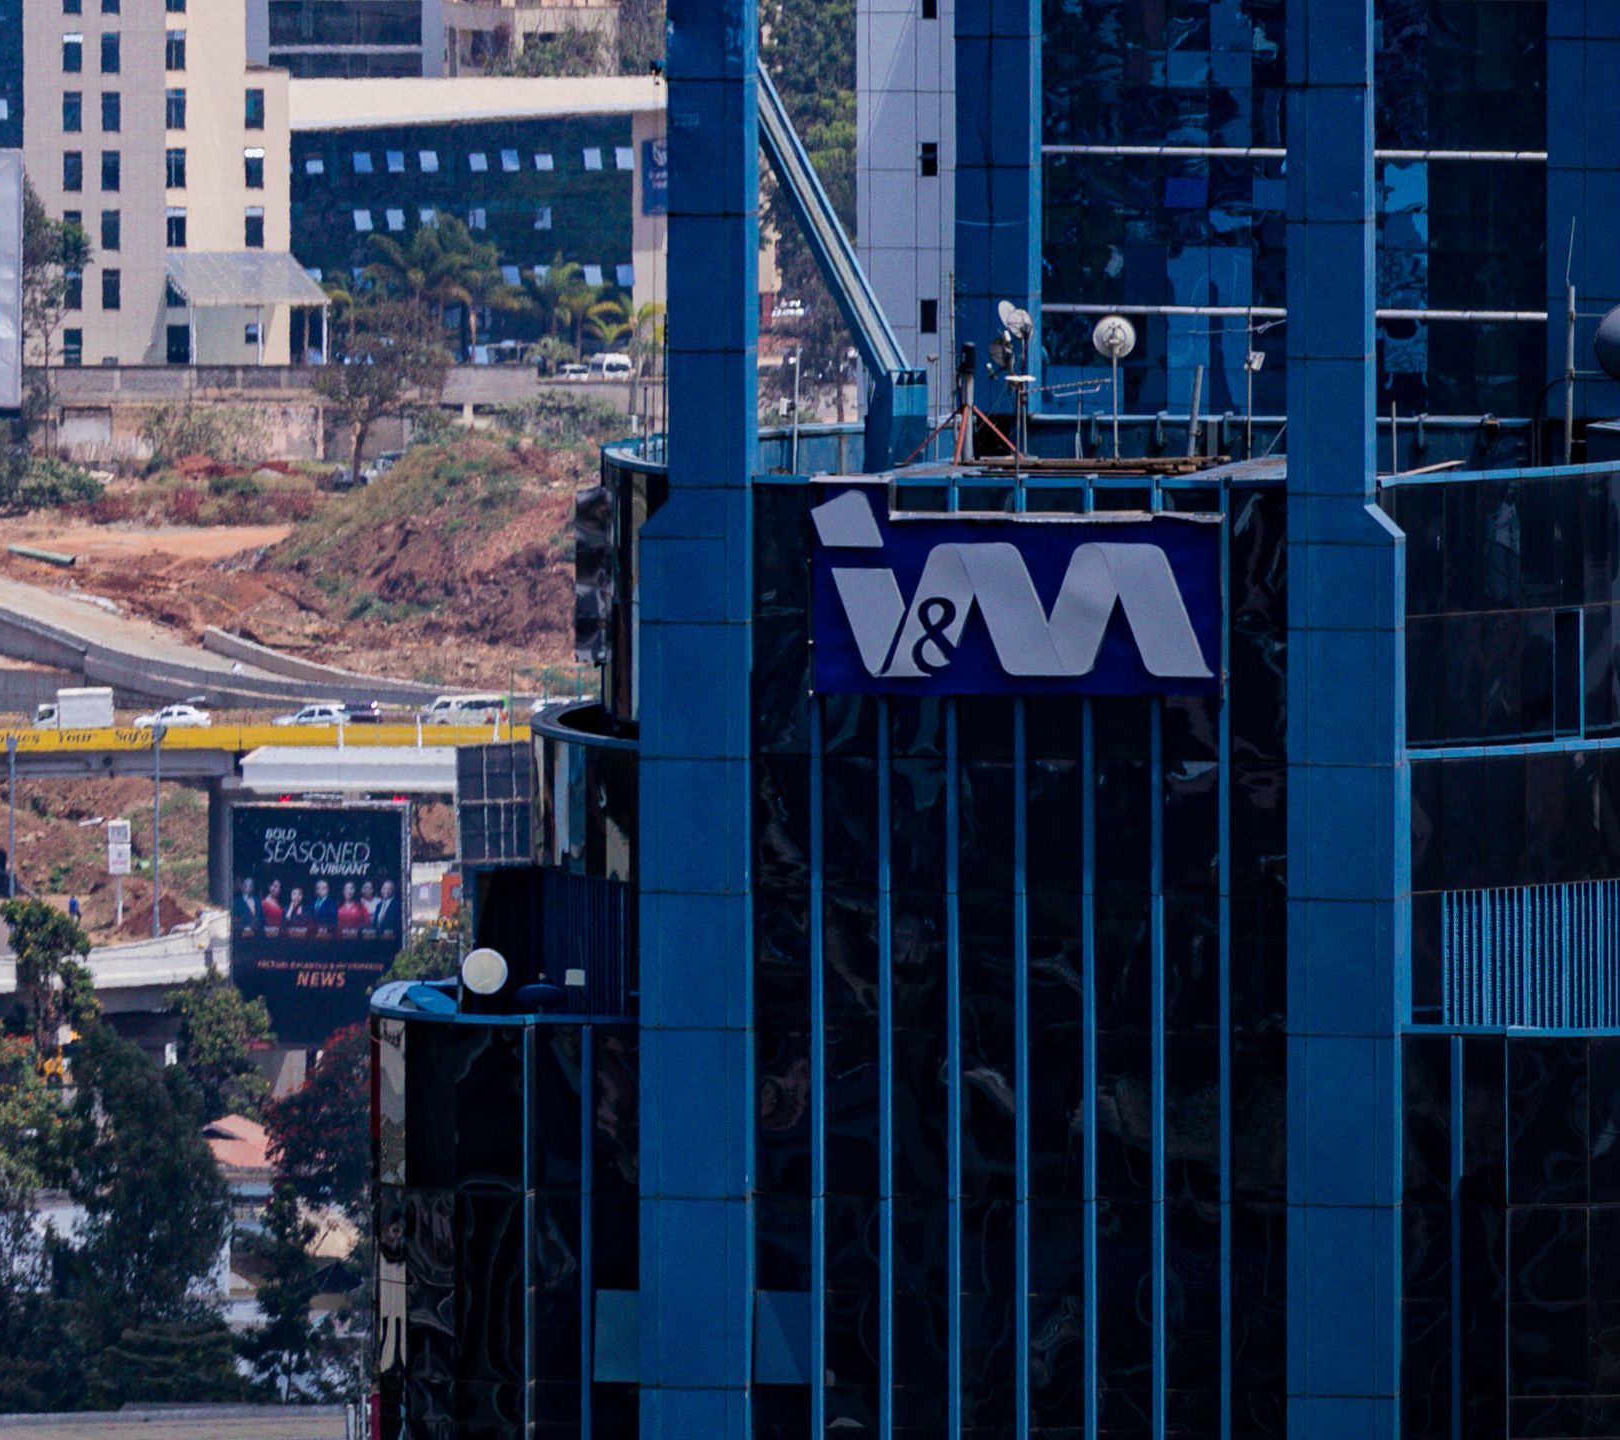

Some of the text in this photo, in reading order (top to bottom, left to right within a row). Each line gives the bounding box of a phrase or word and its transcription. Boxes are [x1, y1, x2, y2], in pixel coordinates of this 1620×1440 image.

[264, 827, 297, 841] BOLD
[263, 840, 371, 864] SEASONED
[296, 971, 347, 988] NEWS
